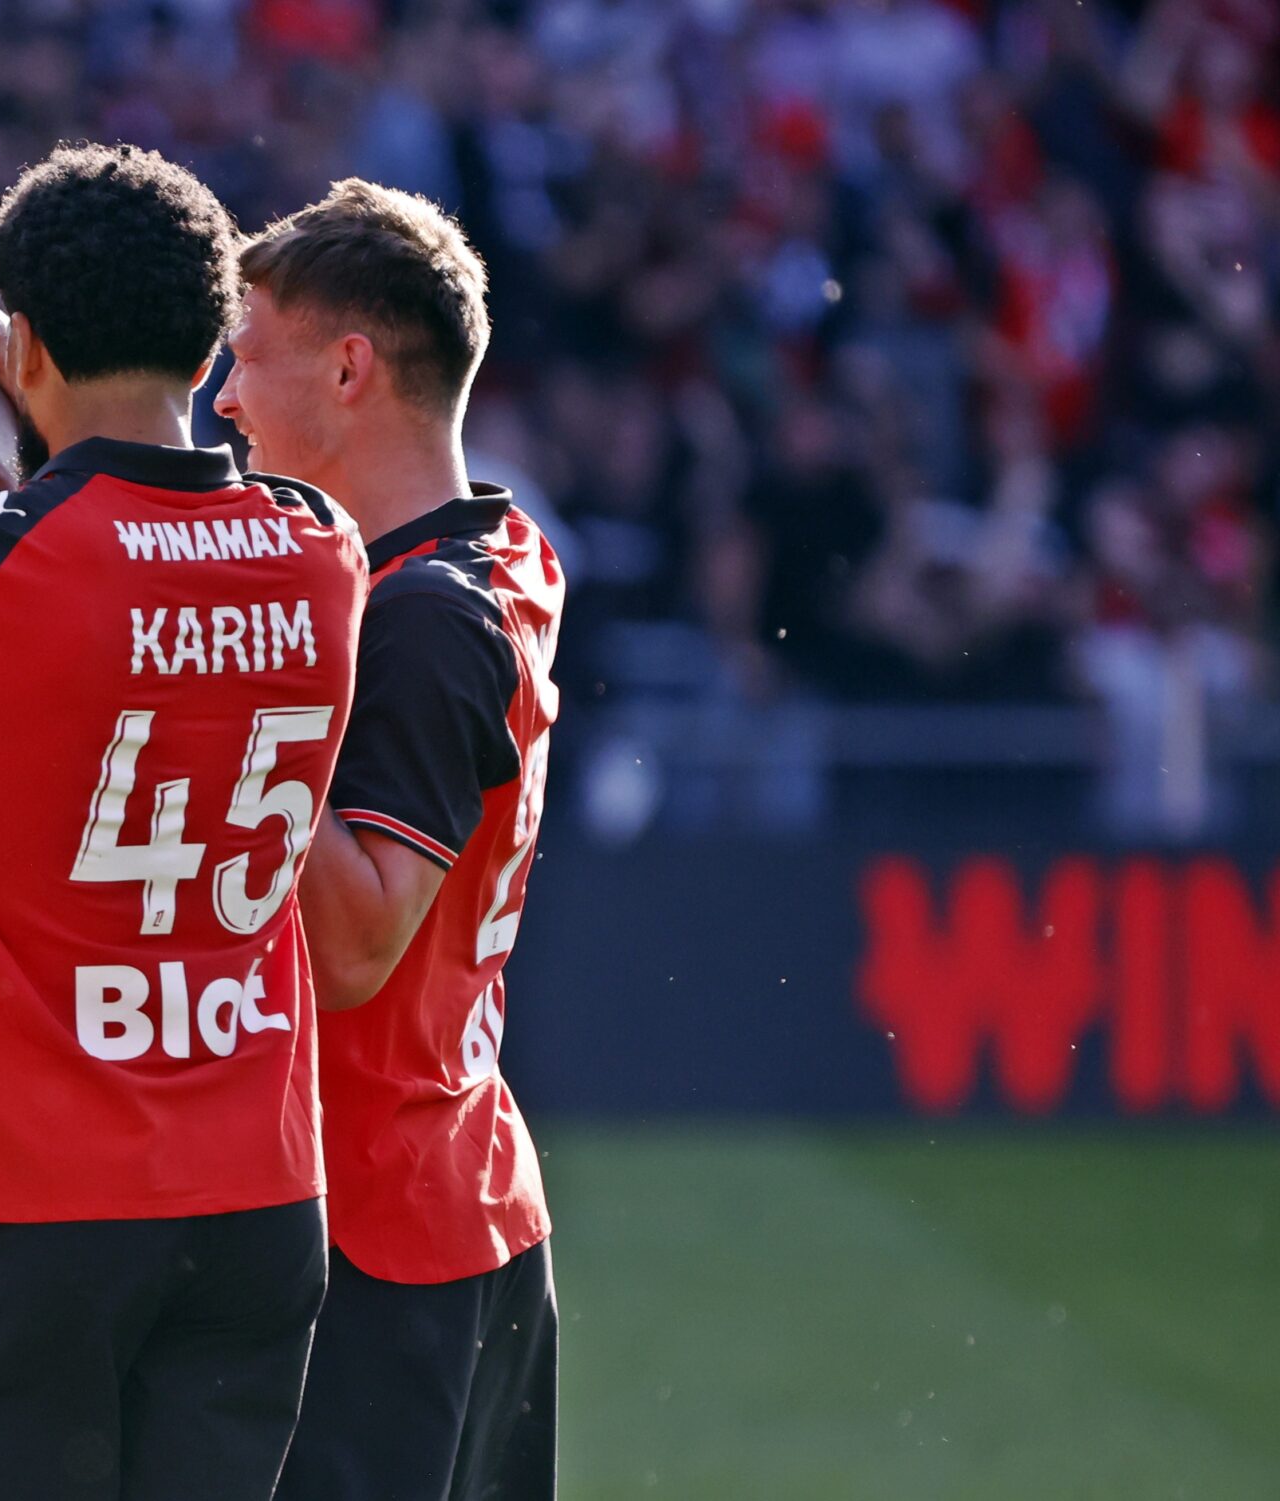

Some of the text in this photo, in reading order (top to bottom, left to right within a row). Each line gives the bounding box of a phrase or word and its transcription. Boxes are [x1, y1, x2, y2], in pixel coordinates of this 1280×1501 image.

[114, 516, 305, 561] WINAMAX
[131, 599, 318, 676] KARIM
[69, 705, 335, 935] 45
[75, 957, 292, 1061] Blot
